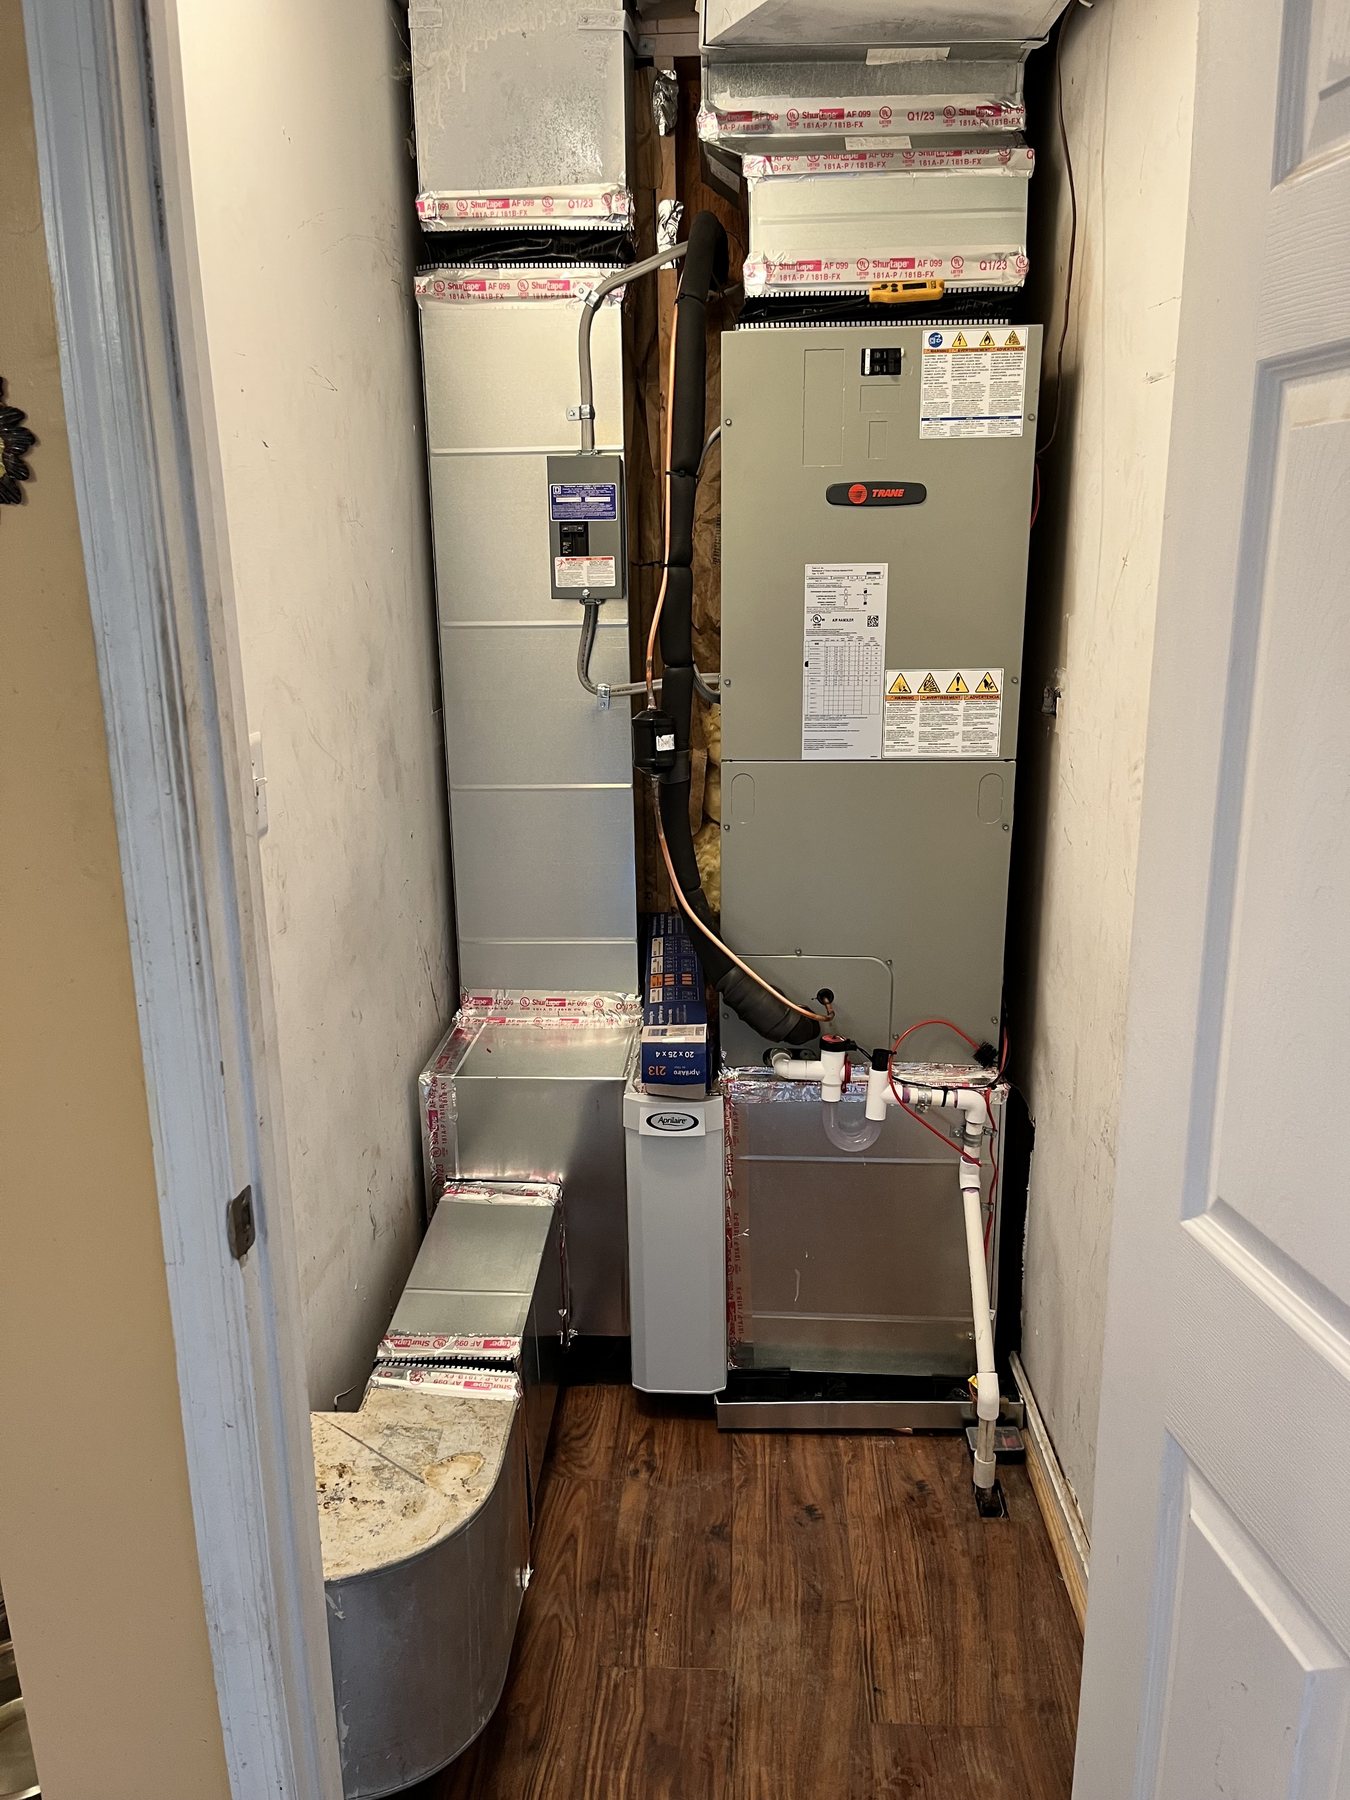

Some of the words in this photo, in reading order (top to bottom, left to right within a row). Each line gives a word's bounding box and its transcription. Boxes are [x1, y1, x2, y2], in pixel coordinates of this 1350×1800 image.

[802, 109, 839, 120] Shurtape
[907, 111, 935, 121] Q1/23
[834, 121, 863, 129] 181B-FX
[991, 118, 1021, 126] 181B-FX
[470, 200, 505, 209] Shurtape
[523, 199, 535, 207] 099
[568, 199, 594, 209] Q1/23
[501, 210, 528, 218] 181B-FX
[872, 260, 909, 269] Shurtape
[930, 259, 942, 267] 099
[980, 260, 1008, 271] Q1/23
[779, 273, 804, 281] 181A-P
[873, 271, 898, 279] 181A-P
[905, 270, 935, 278] 181B-FX
[447, 281, 481, 292] Shurtape
[488, 282, 497, 290] AF
[499, 282, 510, 290] 099
[531, 281, 565, 291] Shurtape
[872, 488, 905, 498] TRANE
[648, 1065, 666, 1076] 213
